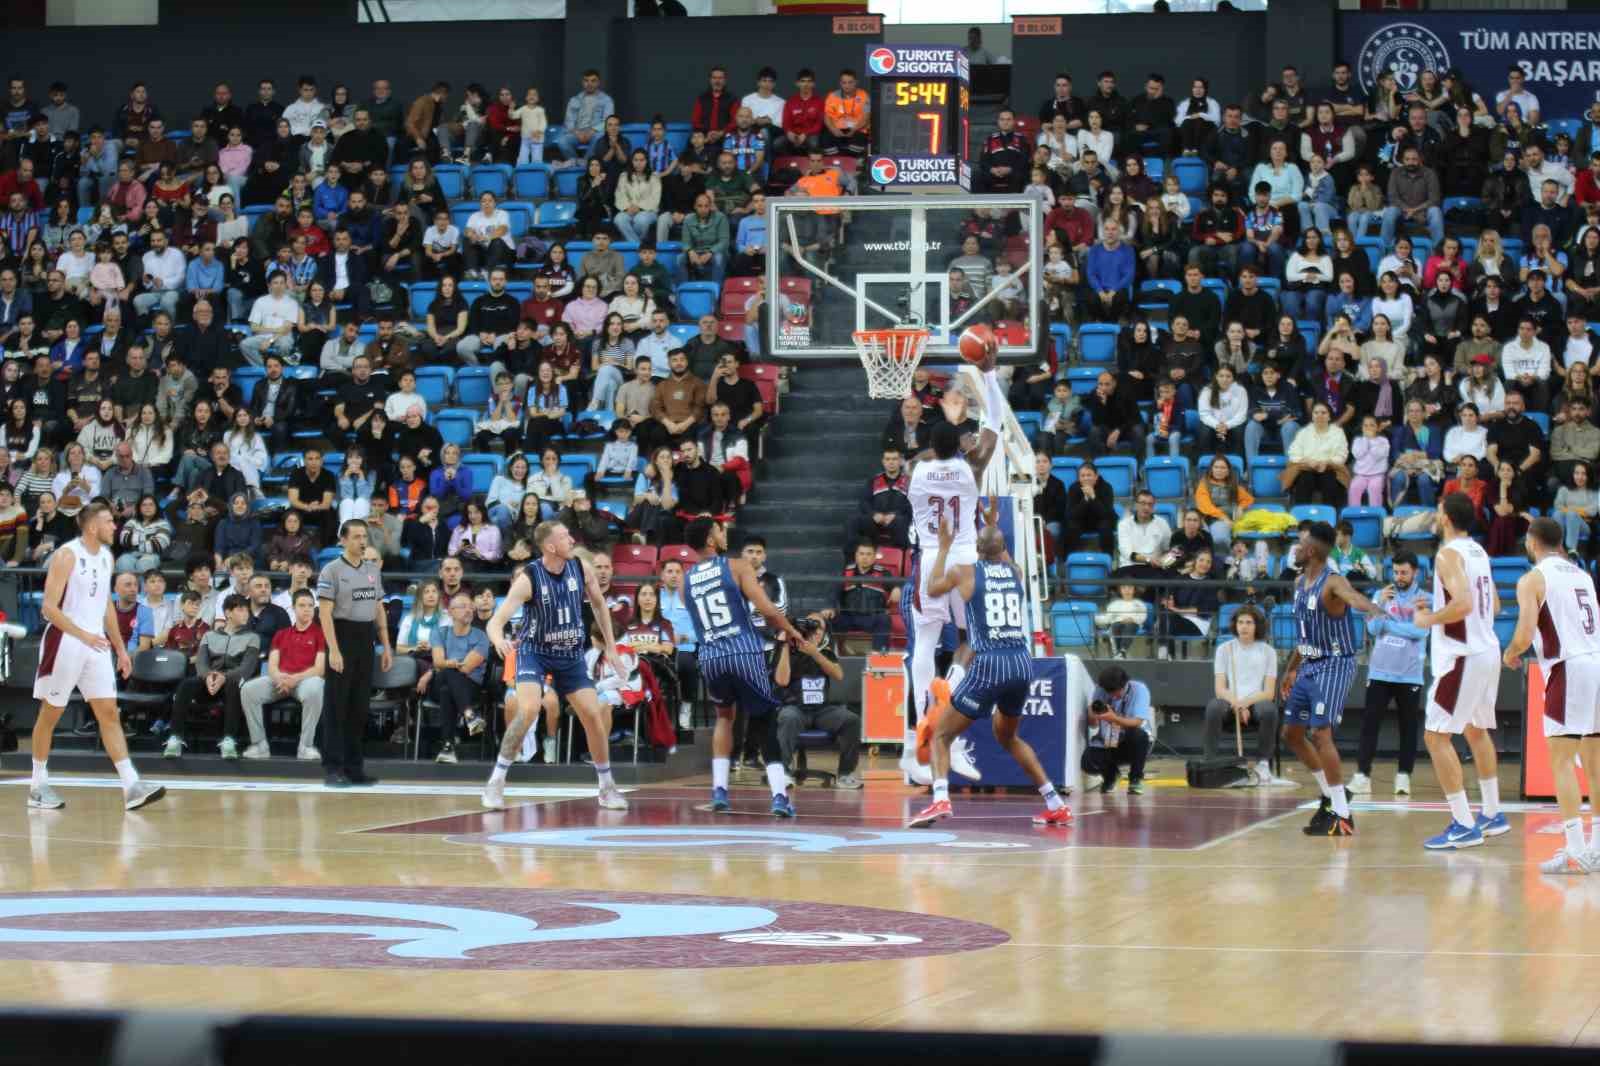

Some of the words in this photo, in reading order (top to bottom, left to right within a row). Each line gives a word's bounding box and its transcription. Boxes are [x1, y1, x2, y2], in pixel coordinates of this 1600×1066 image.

[1027, 24, 1056, 33] BLOK
[1460, 28, 1510, 50] TÜM
[1515, 31, 1600, 50] ANTREN
[1517, 60, 1600, 87] BAŞAR
[896, 81, 947, 105] 5:44
[917, 112, 941, 156] 7
[927, 495, 960, 536] 31
[557, 607, 570, 625] 11
[694, 591, 733, 630] 15
[984, 592, 1021, 627] 88
[1574, 587, 1595, 635] 5
